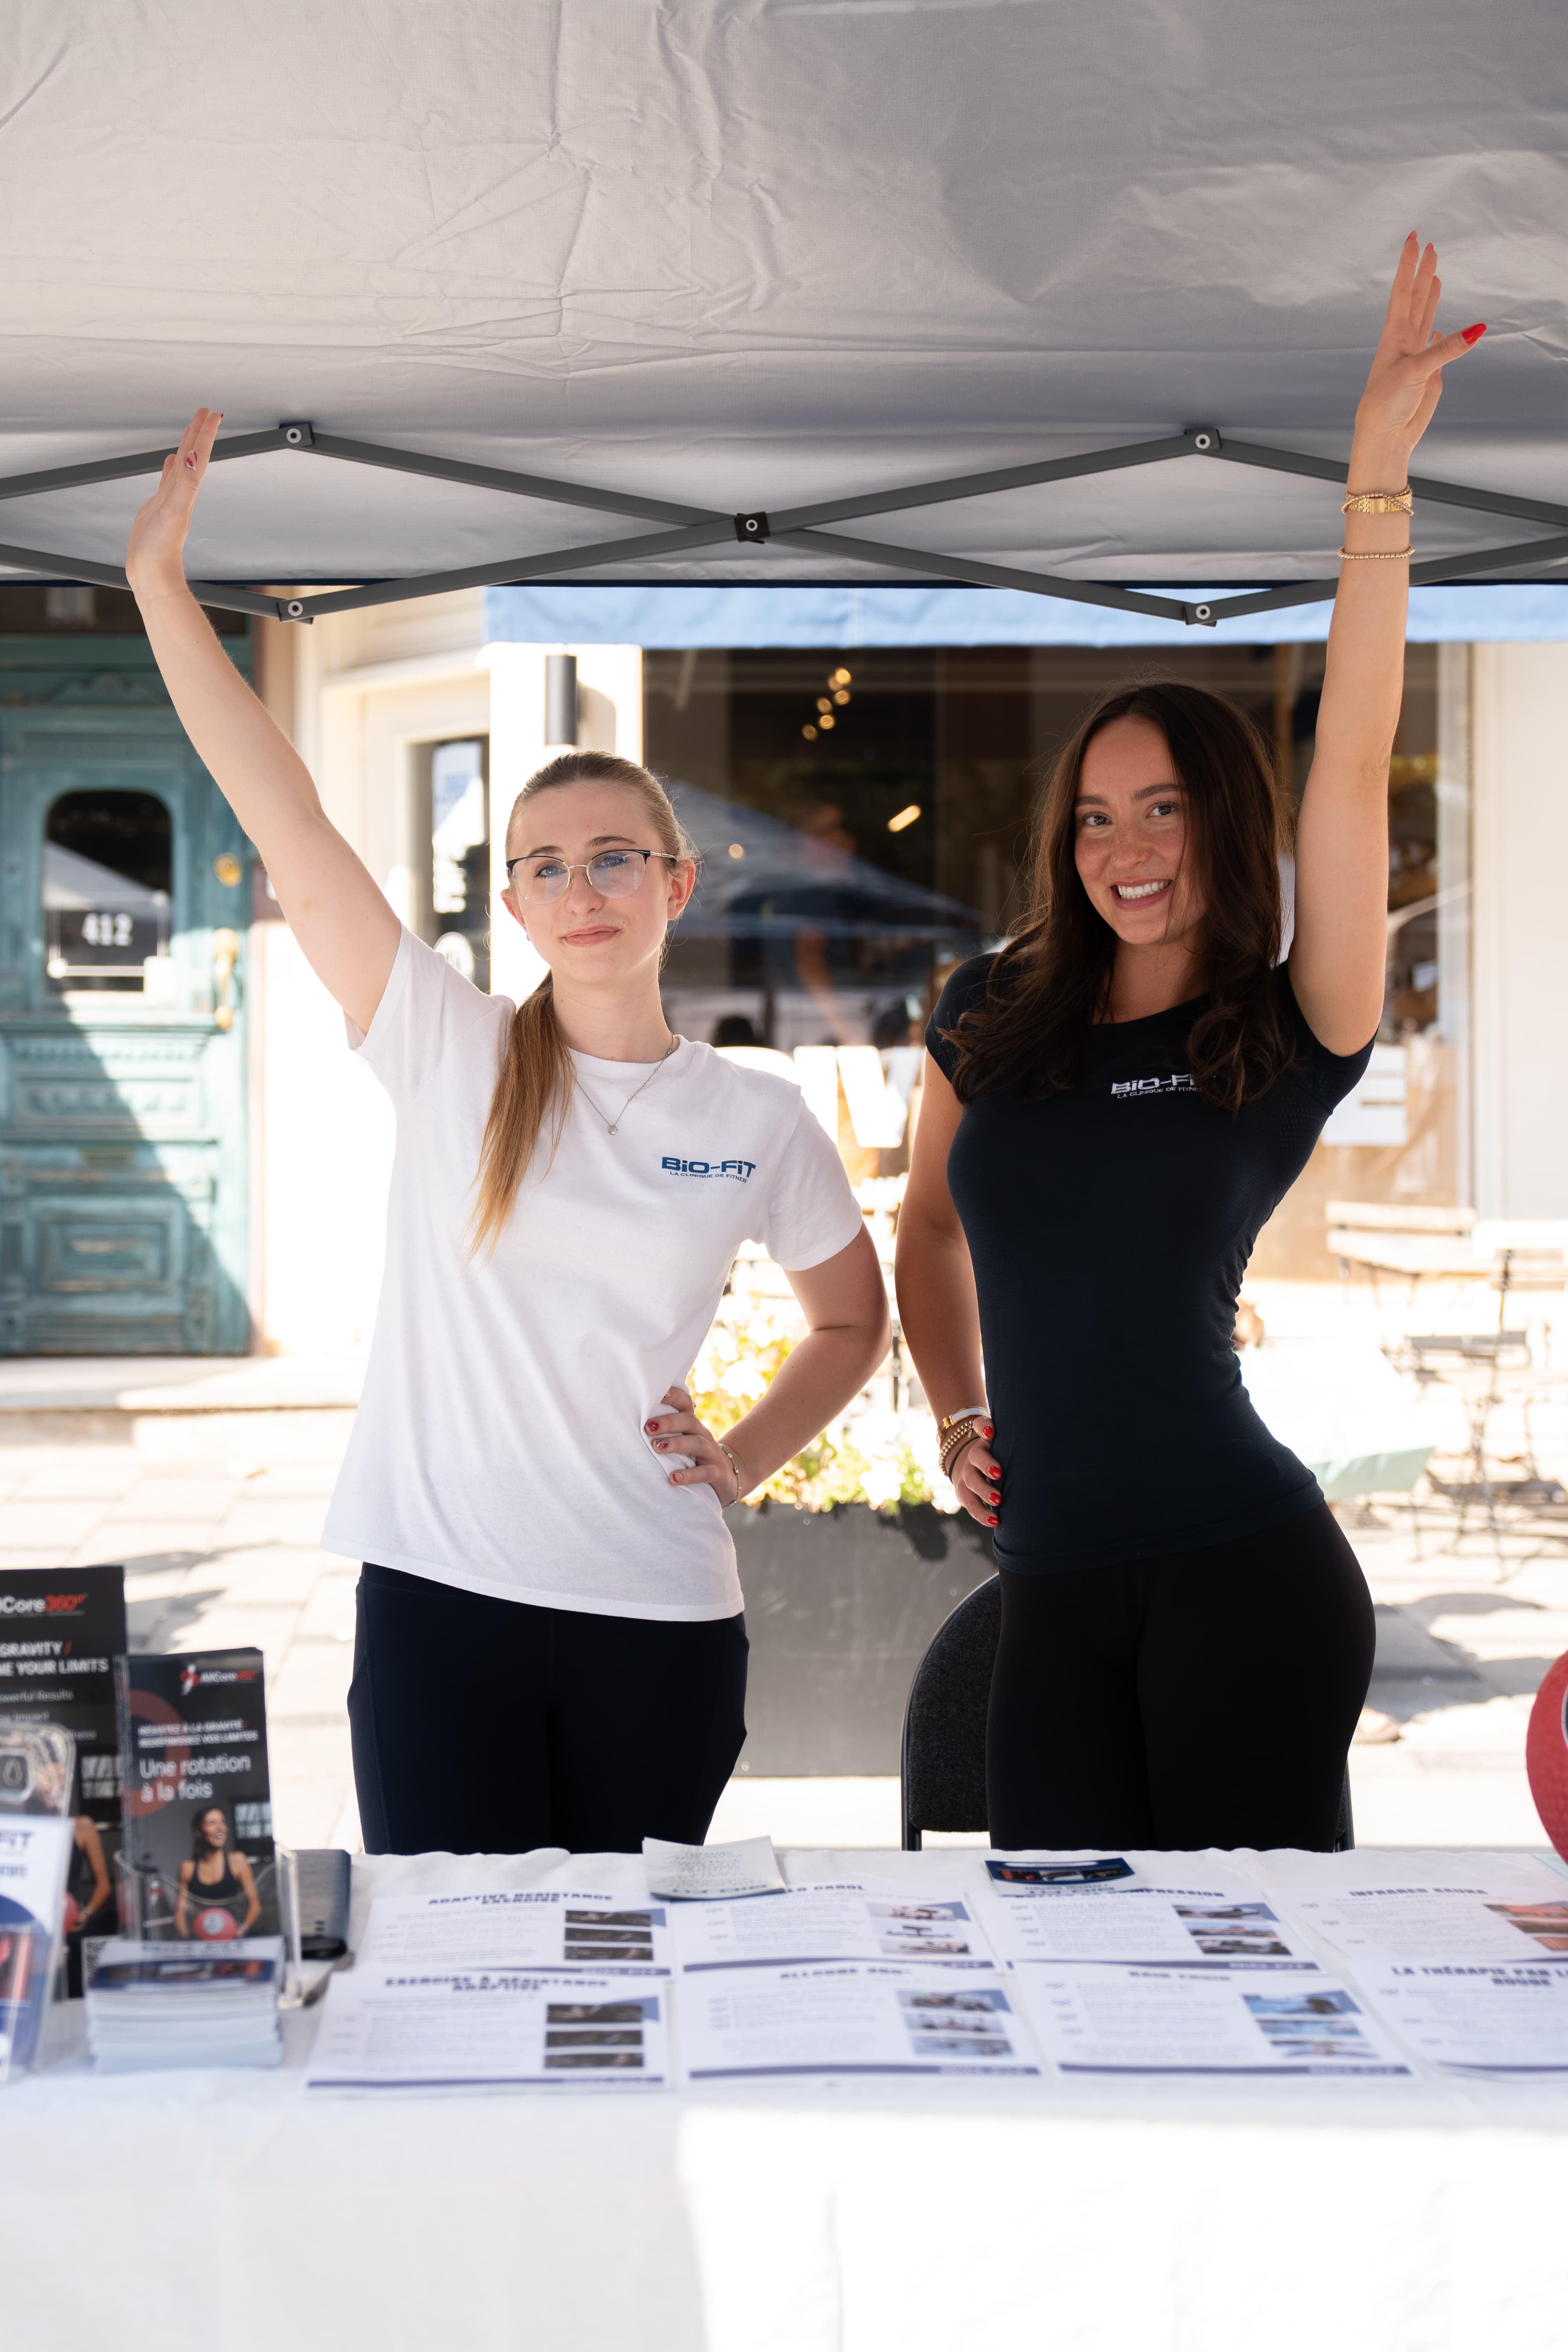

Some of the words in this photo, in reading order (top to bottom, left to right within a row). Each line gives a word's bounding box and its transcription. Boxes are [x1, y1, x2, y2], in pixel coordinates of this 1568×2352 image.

[82, 912, 133, 945] 412
[1111, 1074, 1195, 1094] BiO-Fi
[726, 1174, 747, 1183] FITNESS
[16, 1660, 57, 1676] YOUR
[58, 1658, 109, 1674] LIMITS
[39, 1688, 74, 1701] Results
[140, 1757, 177, 1779] Une
[180, 1754, 251, 1776] rotation
[141, 1782, 153, 1802] à
[157, 1781, 174, 1801] la
[178, 1779, 213, 1799] fois
[428, 1893, 507, 1905] ADAPTIVE
[1391, 1967, 1415, 1975] LA
